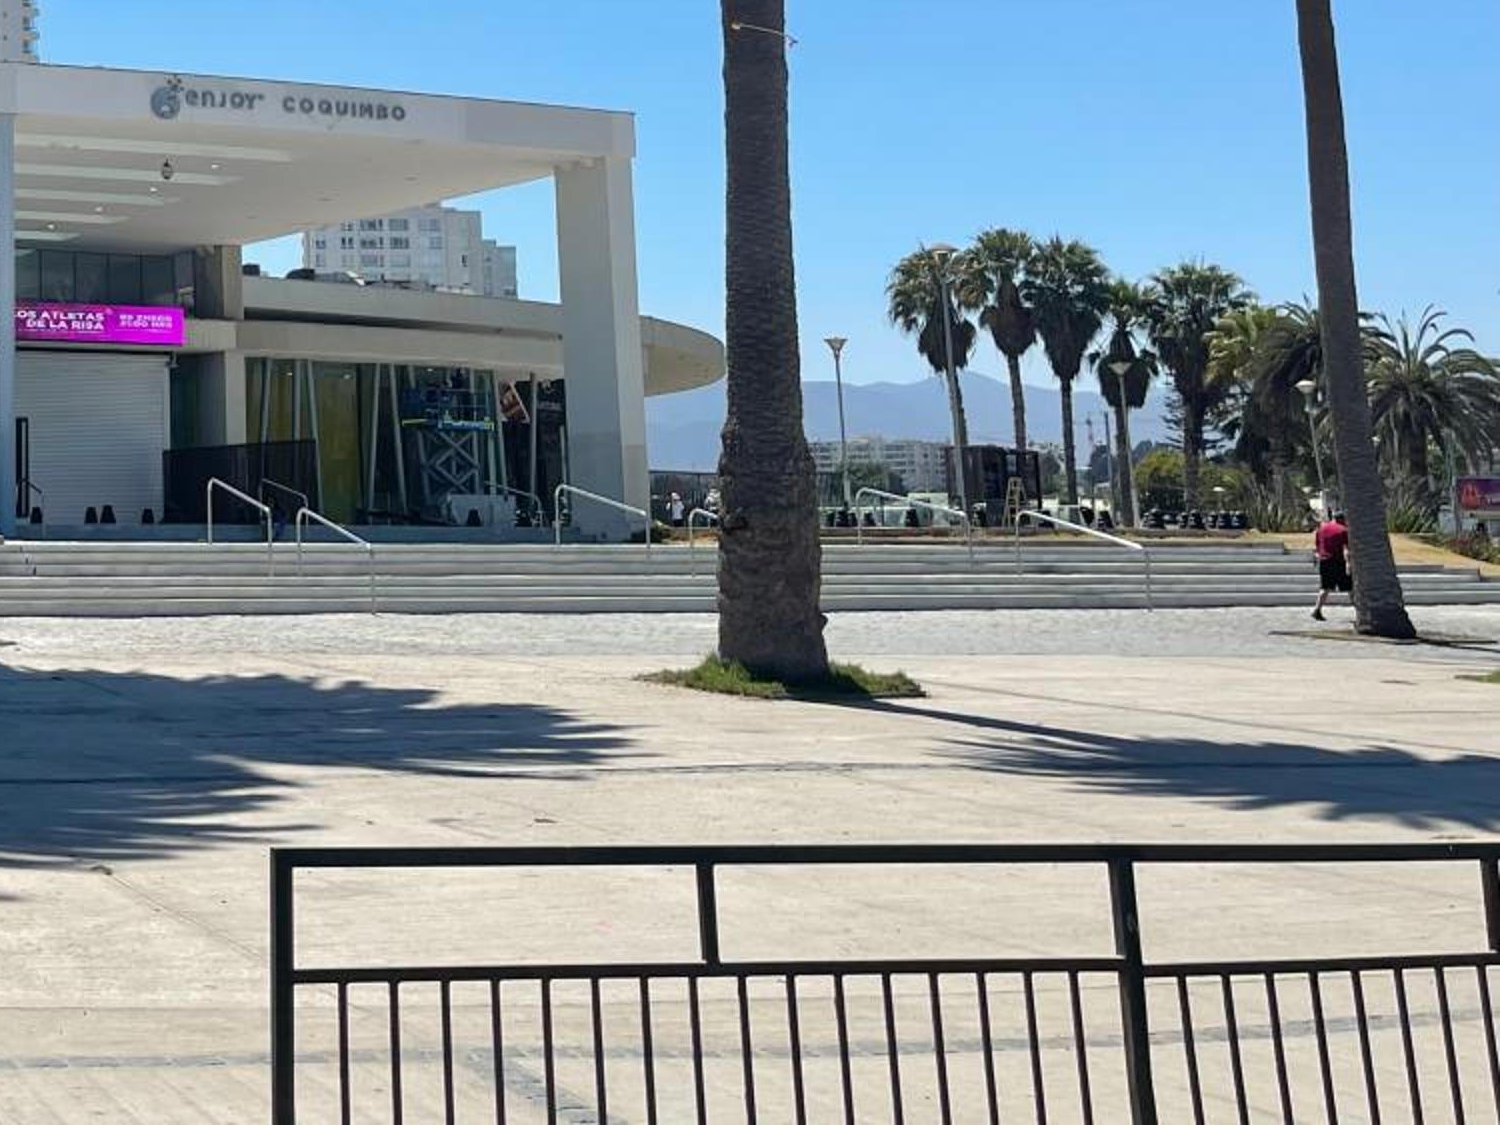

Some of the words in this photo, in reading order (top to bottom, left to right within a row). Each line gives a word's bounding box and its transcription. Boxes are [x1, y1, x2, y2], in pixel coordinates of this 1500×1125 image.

[282, 96, 406, 121] COQUIMBO
[41, 310, 105, 320] ATLETAS
[26, 317, 46, 328] DE
[49, 319, 68, 329] LA
[71, 320, 105, 330] RISA
